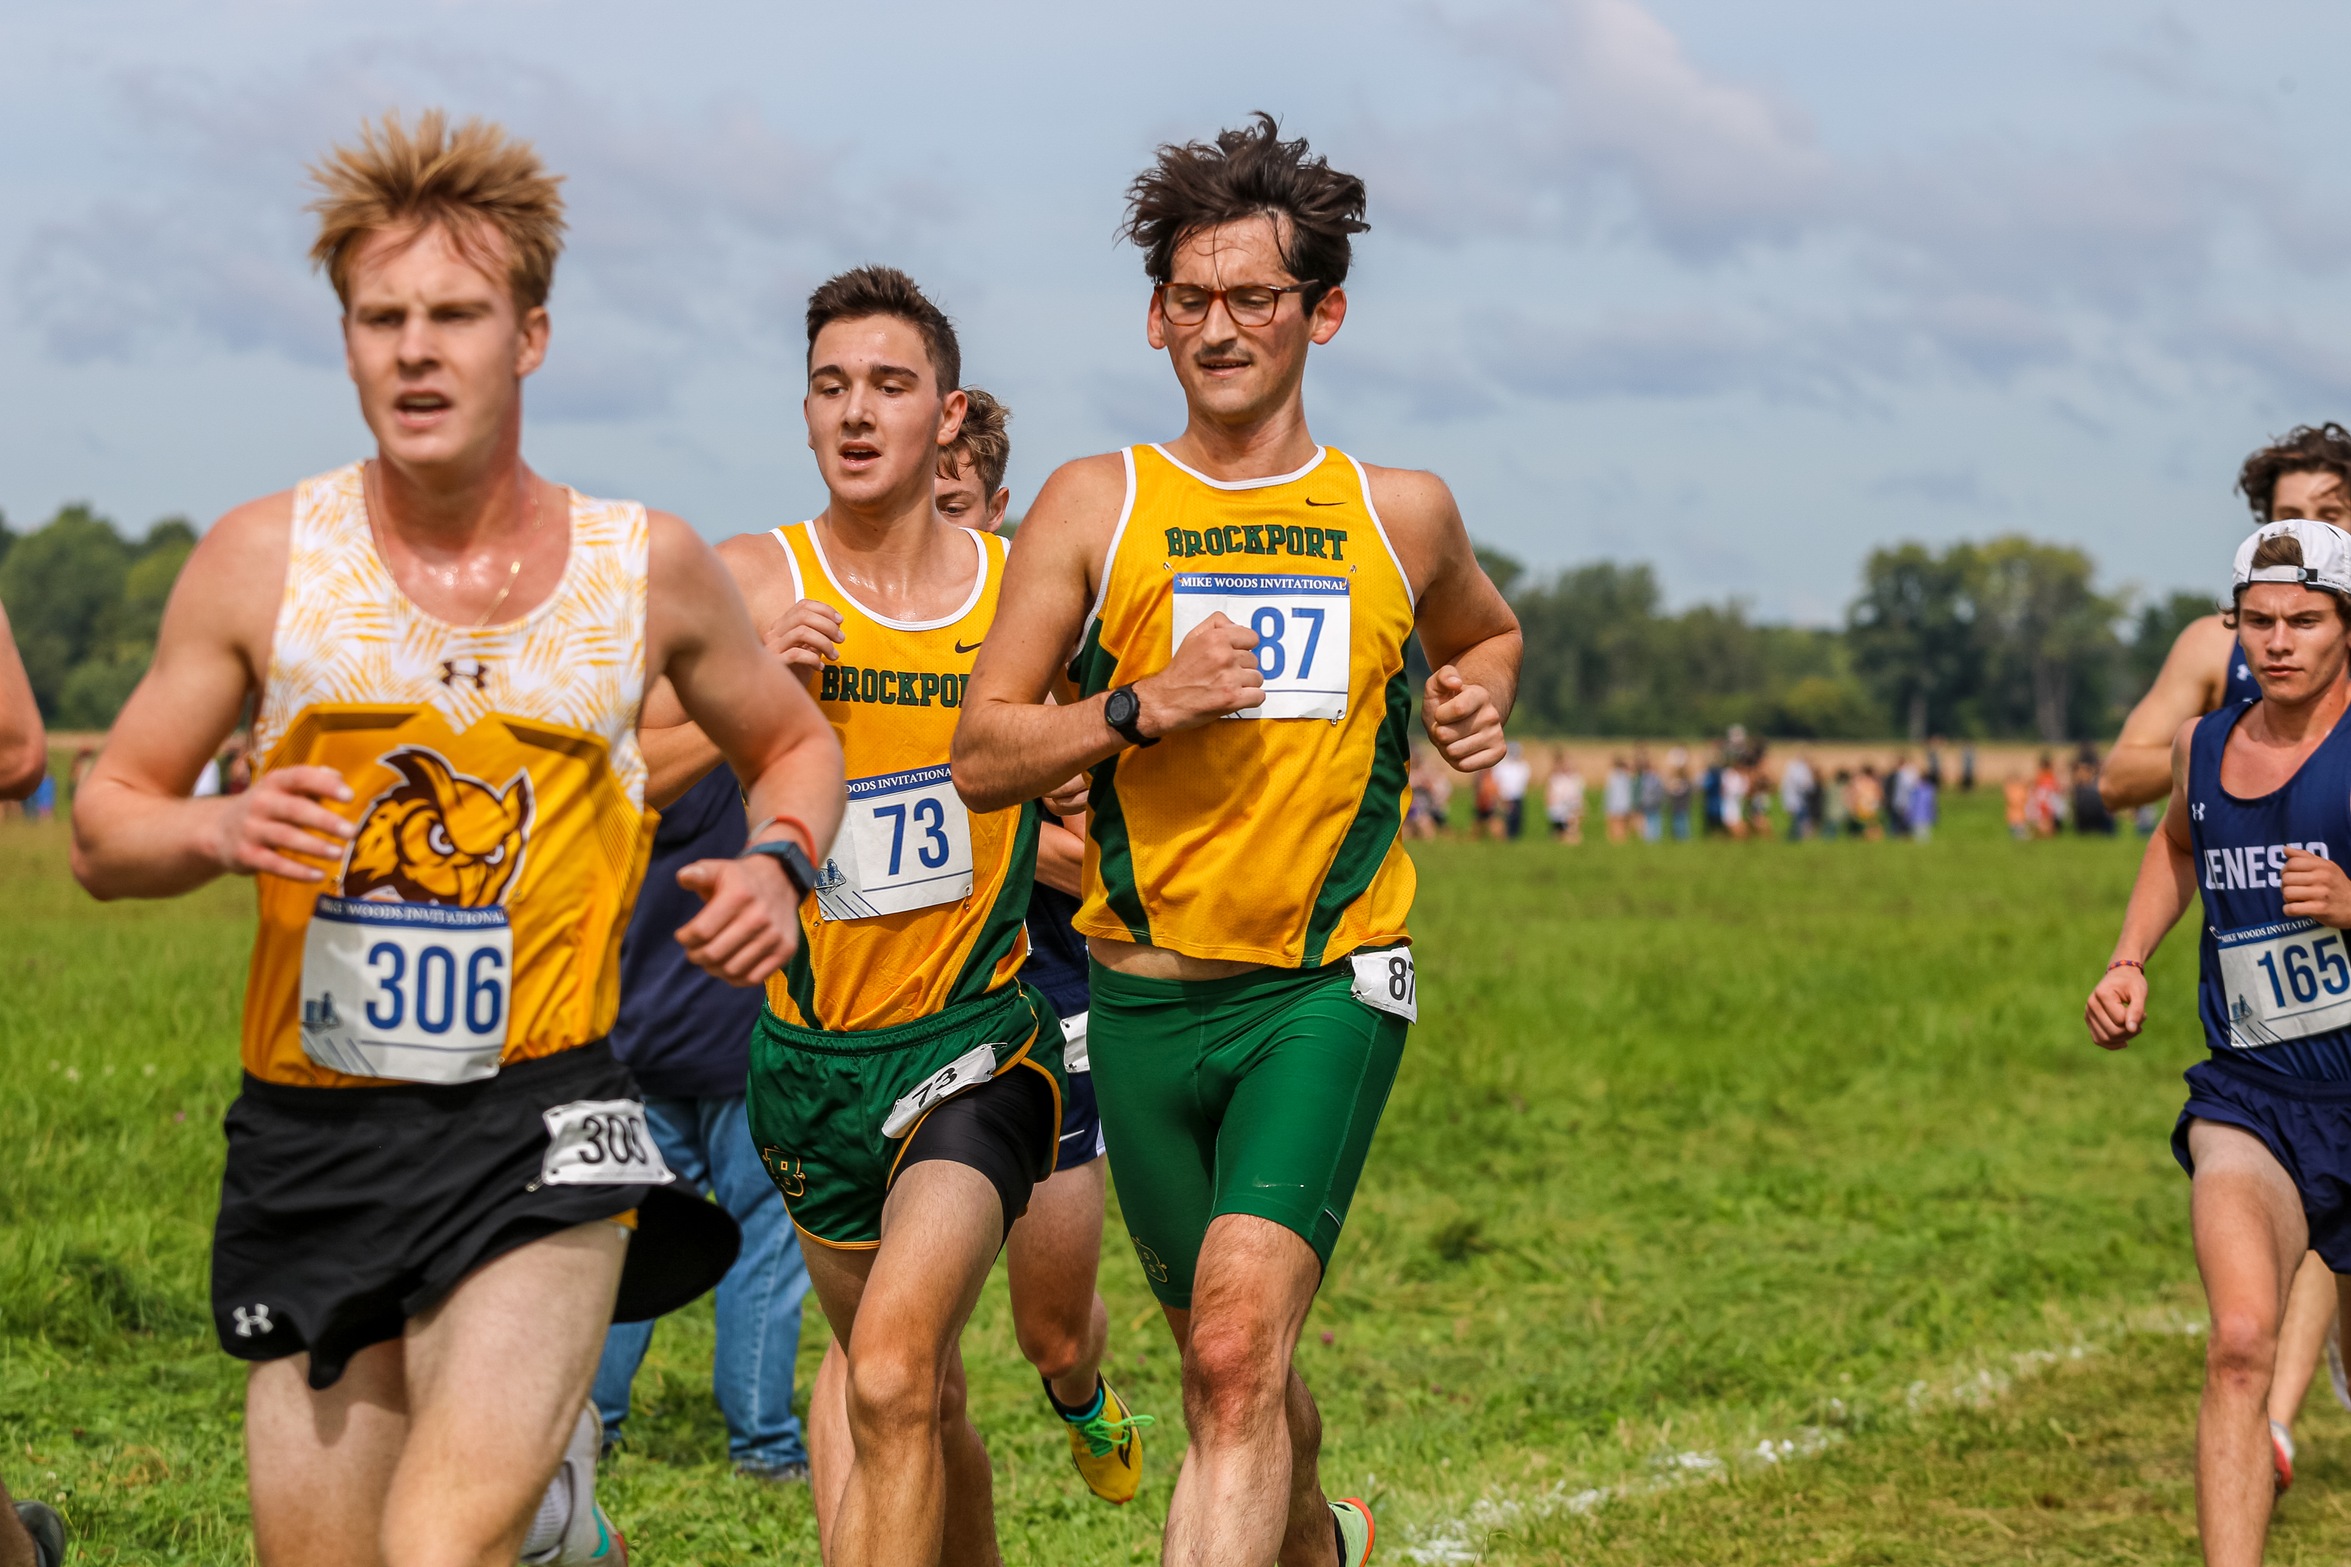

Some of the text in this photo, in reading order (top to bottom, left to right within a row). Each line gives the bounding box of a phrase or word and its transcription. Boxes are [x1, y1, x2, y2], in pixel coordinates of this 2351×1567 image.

[1164, 524, 1348, 561] BROCKPORT
[1181, 577, 1347, 591] MIKE WOODS INVITATIONAL
[1250, 606, 1325, 680] 87
[820, 664, 972, 709] BROCKPO
[845, 767, 952, 794] OODS INVITATIONA
[873, 797, 950, 877] 73
[346, 902, 404, 919] WOODS
[2221, 917, 2316, 944] MIKE WOODS INVITATIO
[366, 941, 505, 1034] 306
[2257, 934, 2351, 1008] 165
[911, 1067, 958, 1109] 73
